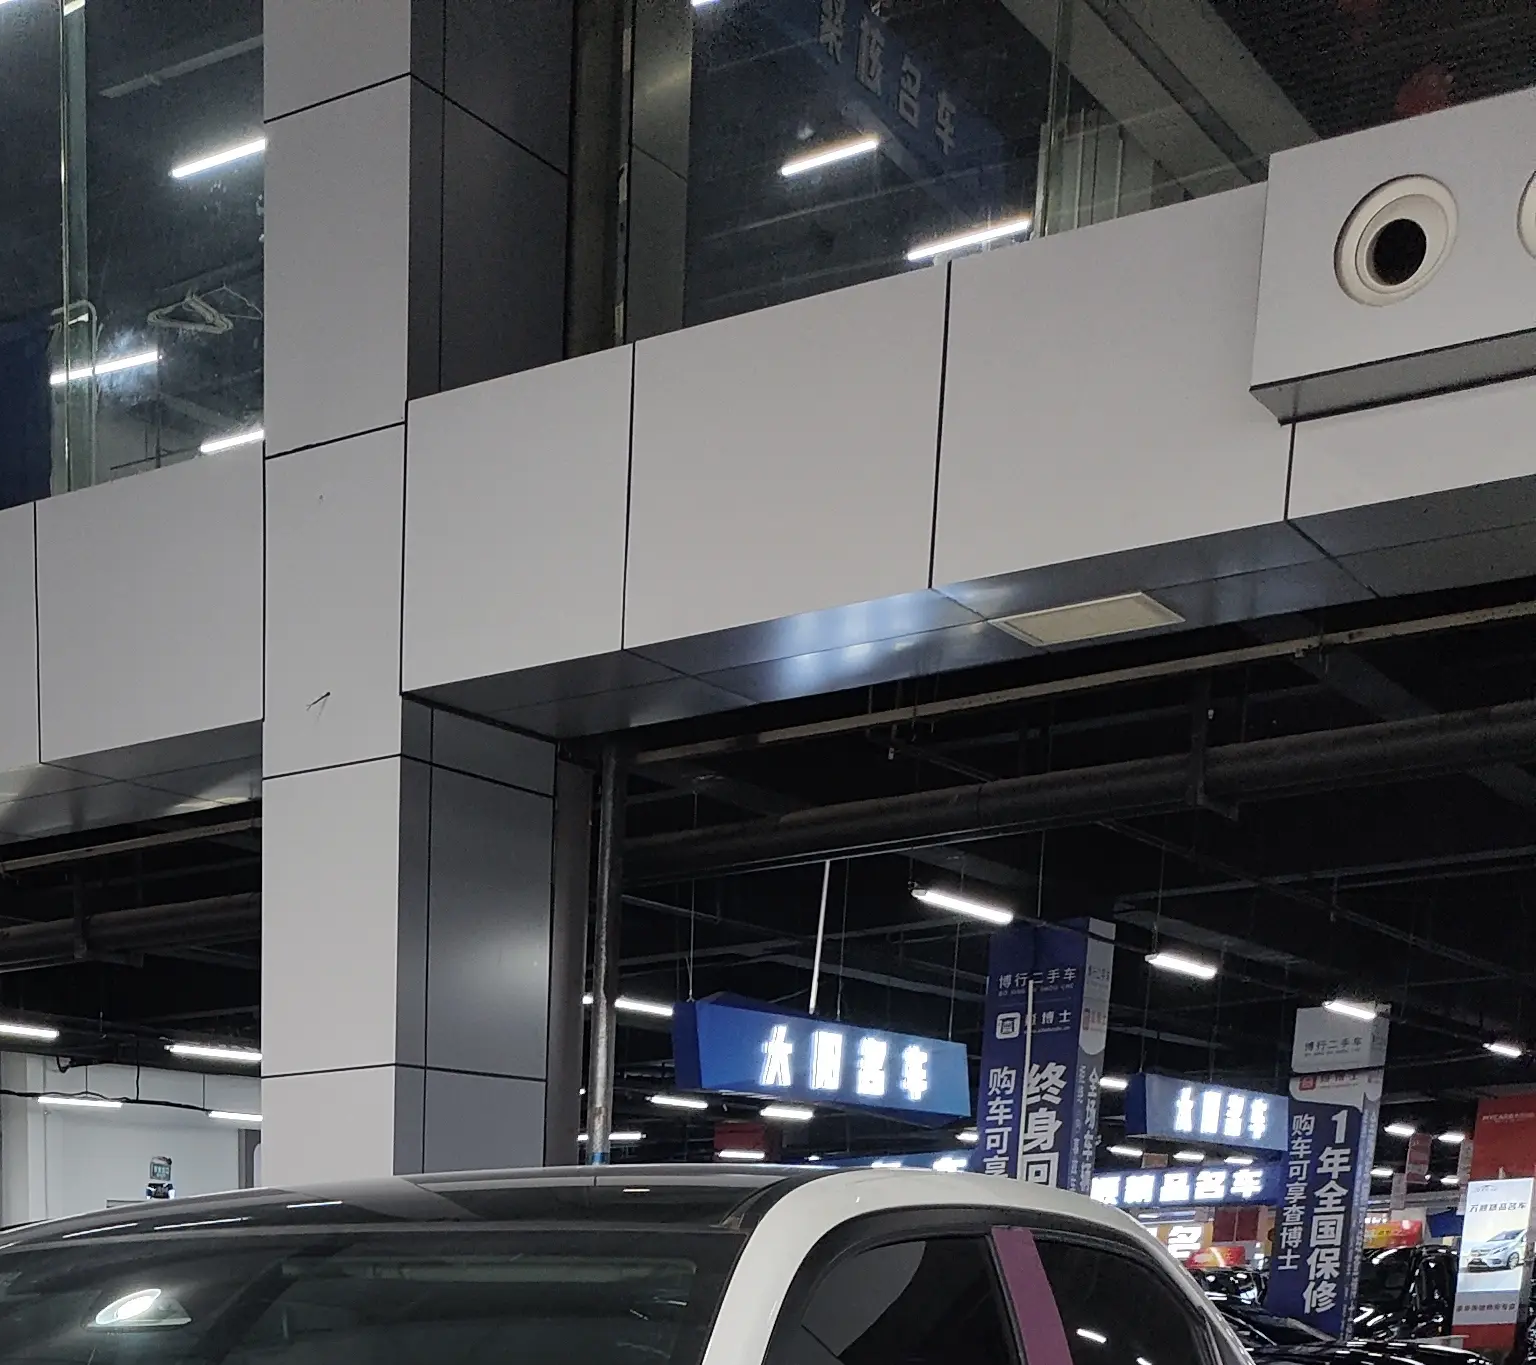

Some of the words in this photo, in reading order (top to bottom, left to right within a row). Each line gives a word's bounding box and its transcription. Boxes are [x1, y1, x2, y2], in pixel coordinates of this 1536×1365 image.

[999, 966, 1077, 989] 博行二手车
[1277, 1114, 1315, 1271] 购车可享查博士
[1302, 1109, 1352, 1315] 1年全国保修
